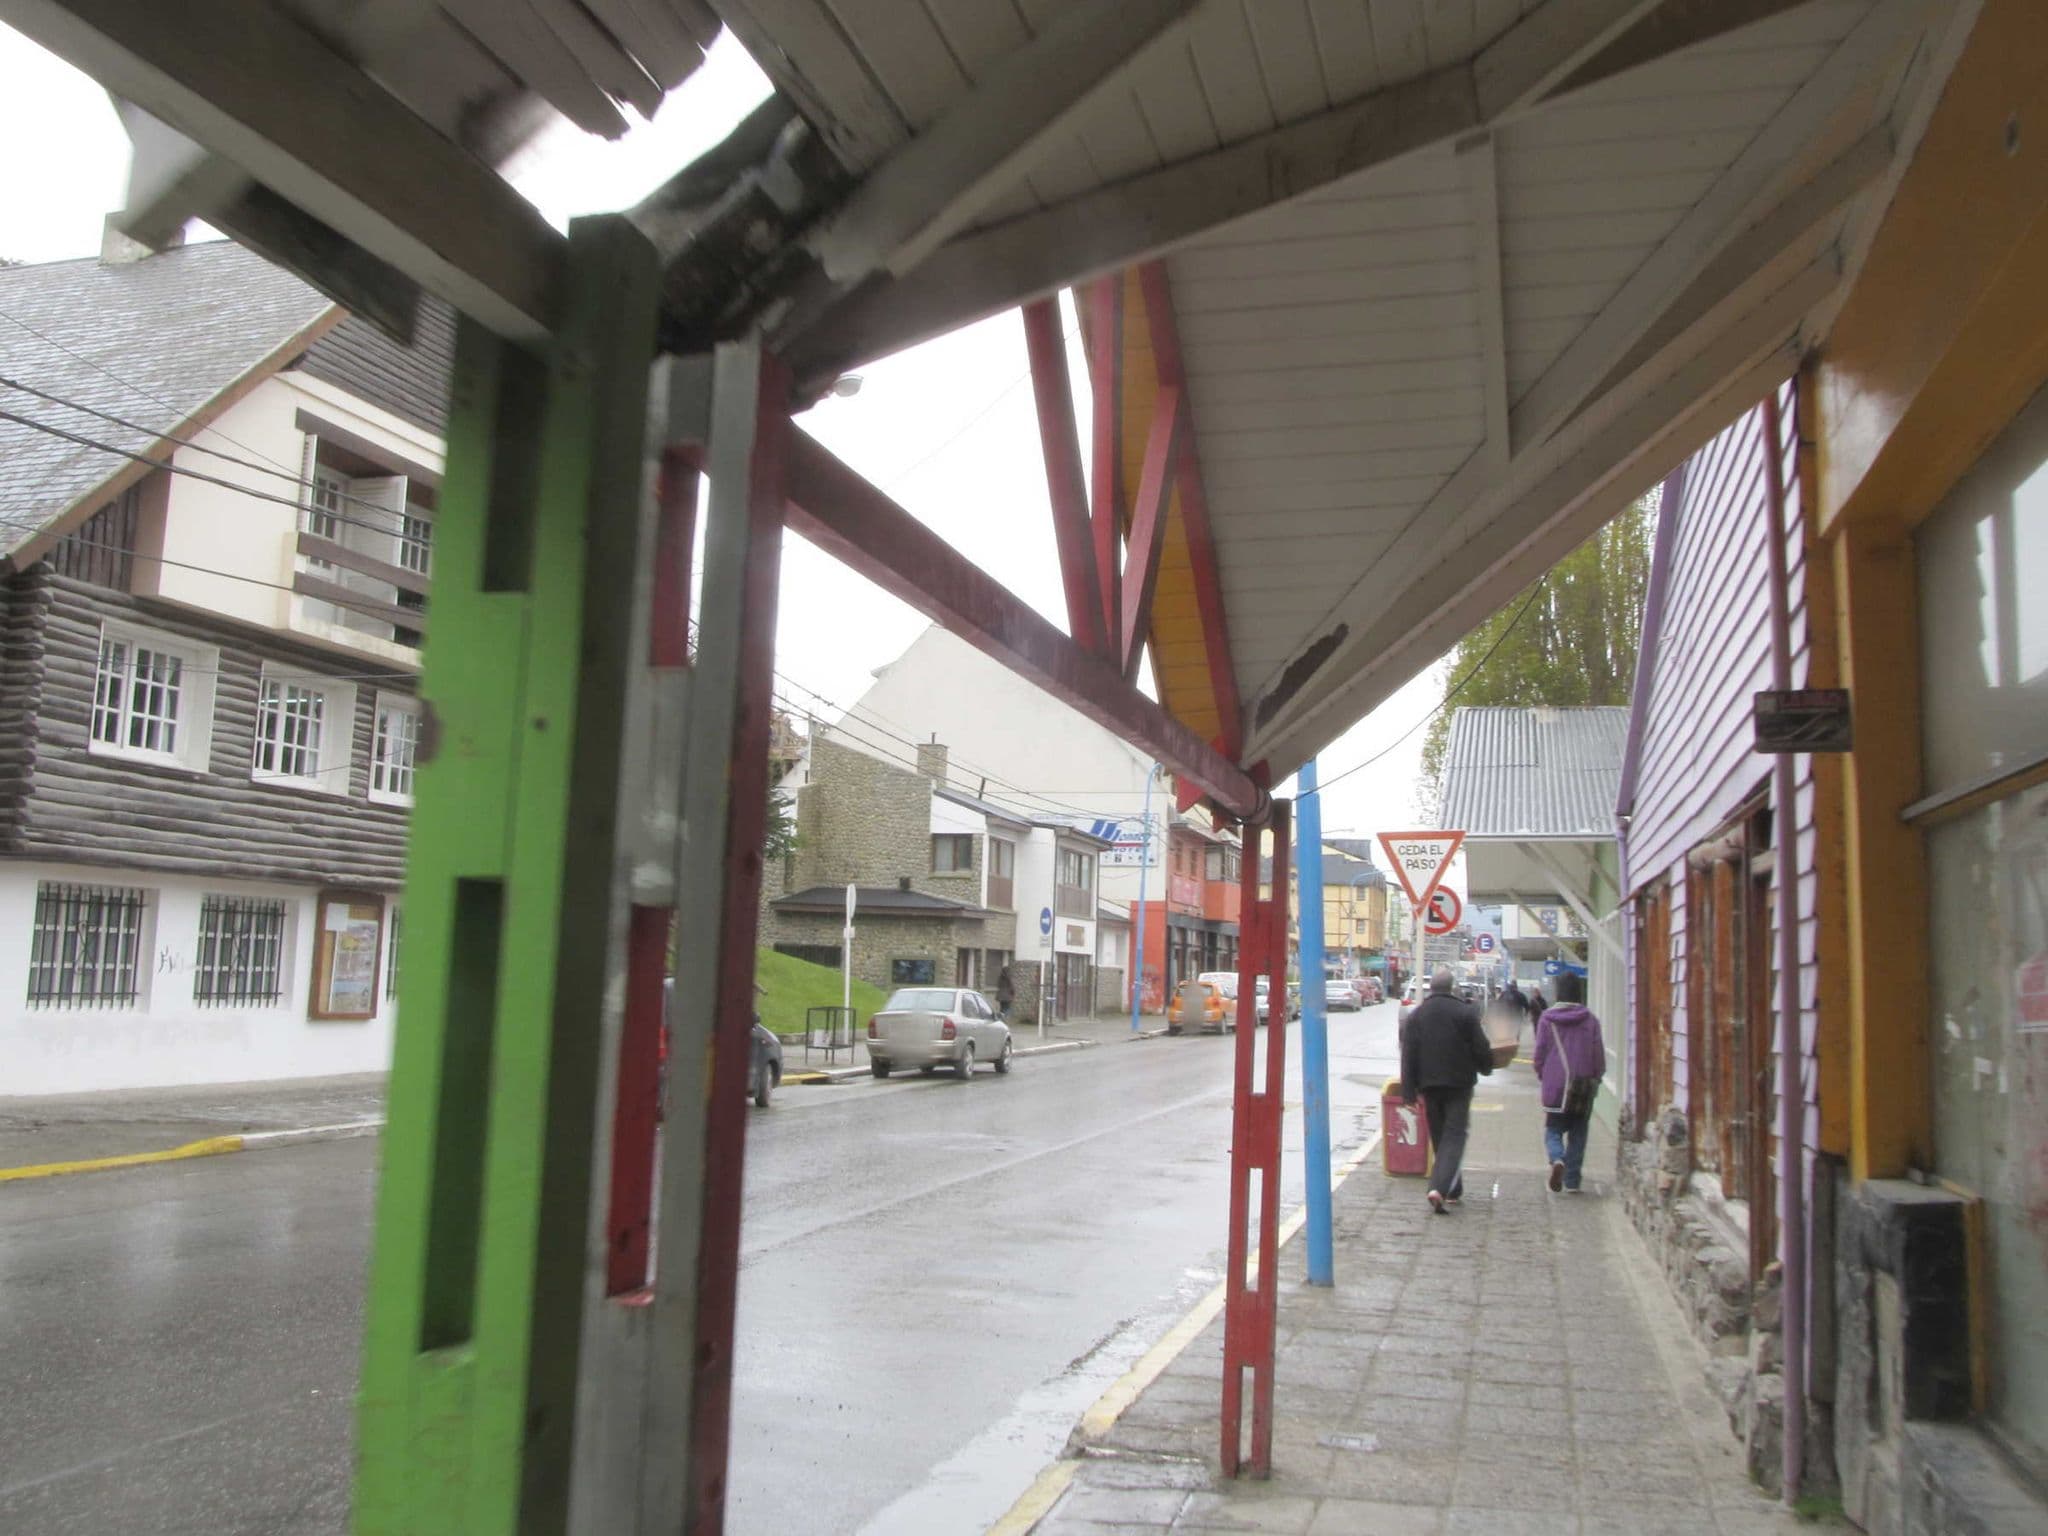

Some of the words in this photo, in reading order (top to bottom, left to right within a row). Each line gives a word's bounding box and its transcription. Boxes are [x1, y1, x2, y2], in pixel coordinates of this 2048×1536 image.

[1398, 845, 1427, 855] CEDA
[1429, 844, 1444, 855] EL
[1406, 859, 1436, 869] PASO
[1481, 937, 1491, 950] E
